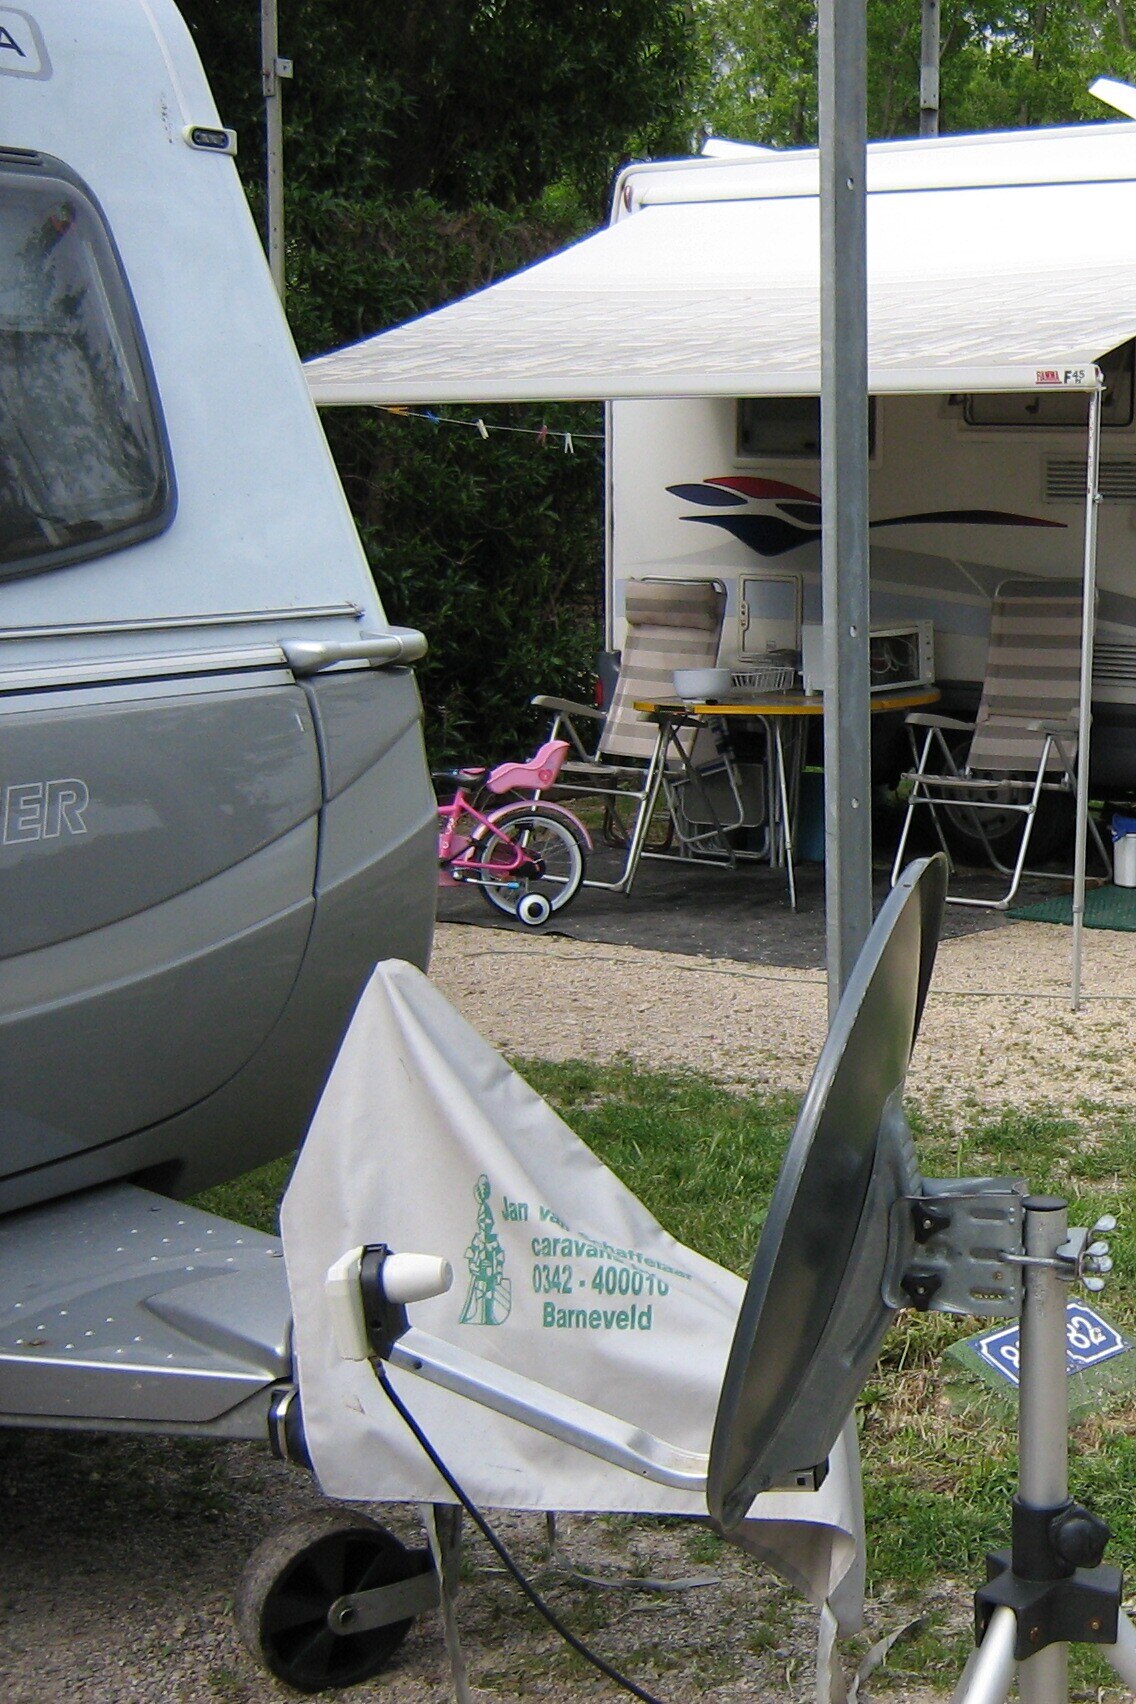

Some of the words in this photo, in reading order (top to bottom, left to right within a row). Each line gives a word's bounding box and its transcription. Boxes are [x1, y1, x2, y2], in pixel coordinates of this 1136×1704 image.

[501, 1196, 528, 1221] Jan
[532, 1263, 573, 1294] 0342
[542, 1300, 653, 1332] Barneveld
